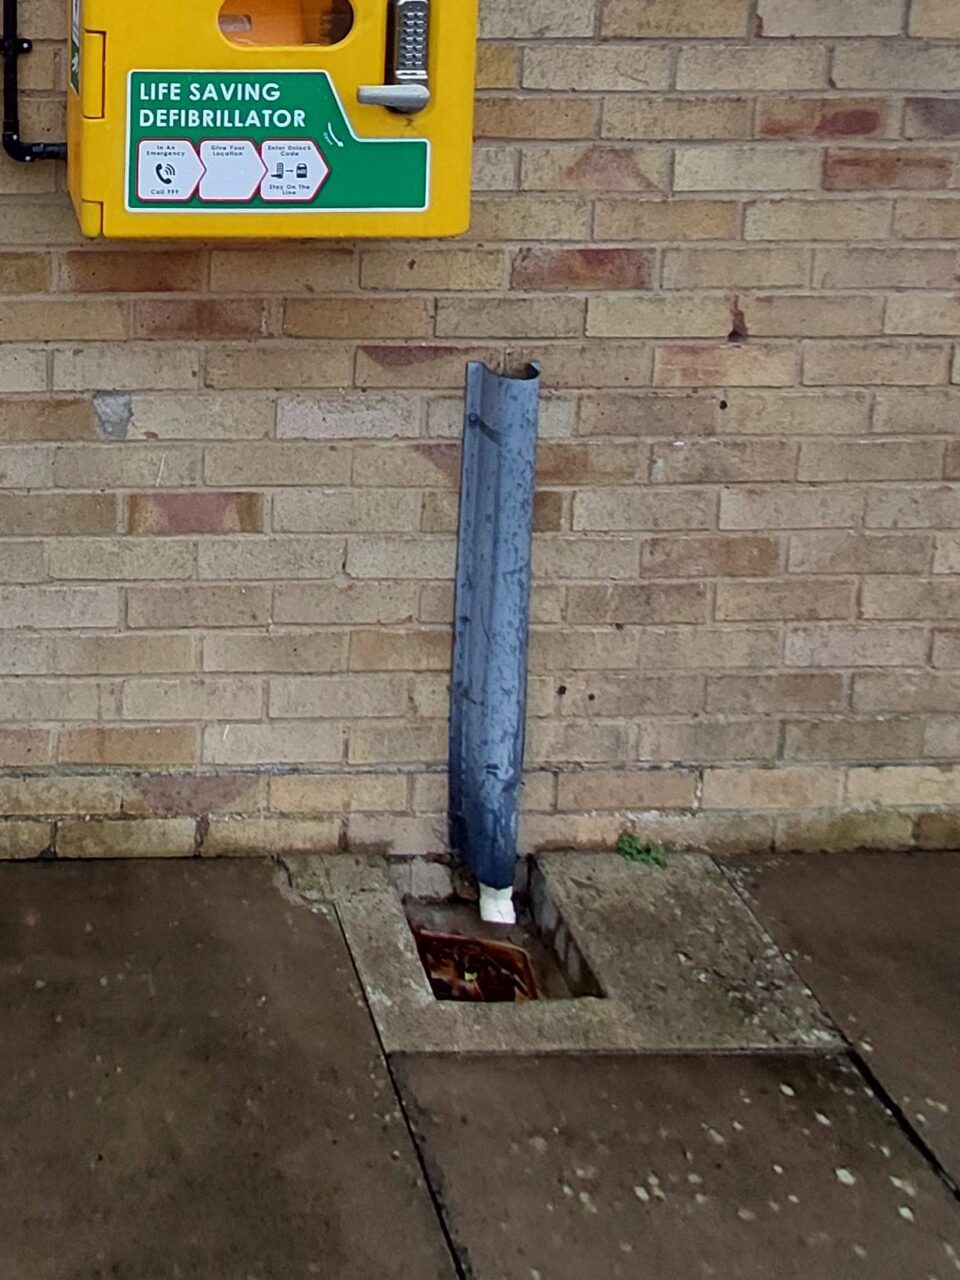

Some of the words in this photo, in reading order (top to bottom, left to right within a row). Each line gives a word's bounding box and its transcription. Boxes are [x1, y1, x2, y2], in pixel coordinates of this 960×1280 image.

[139, 83, 181, 101] LIFE
[189, 83, 280, 101] SAVING
[139, 109, 306, 127] DEFIBRILLATOR
